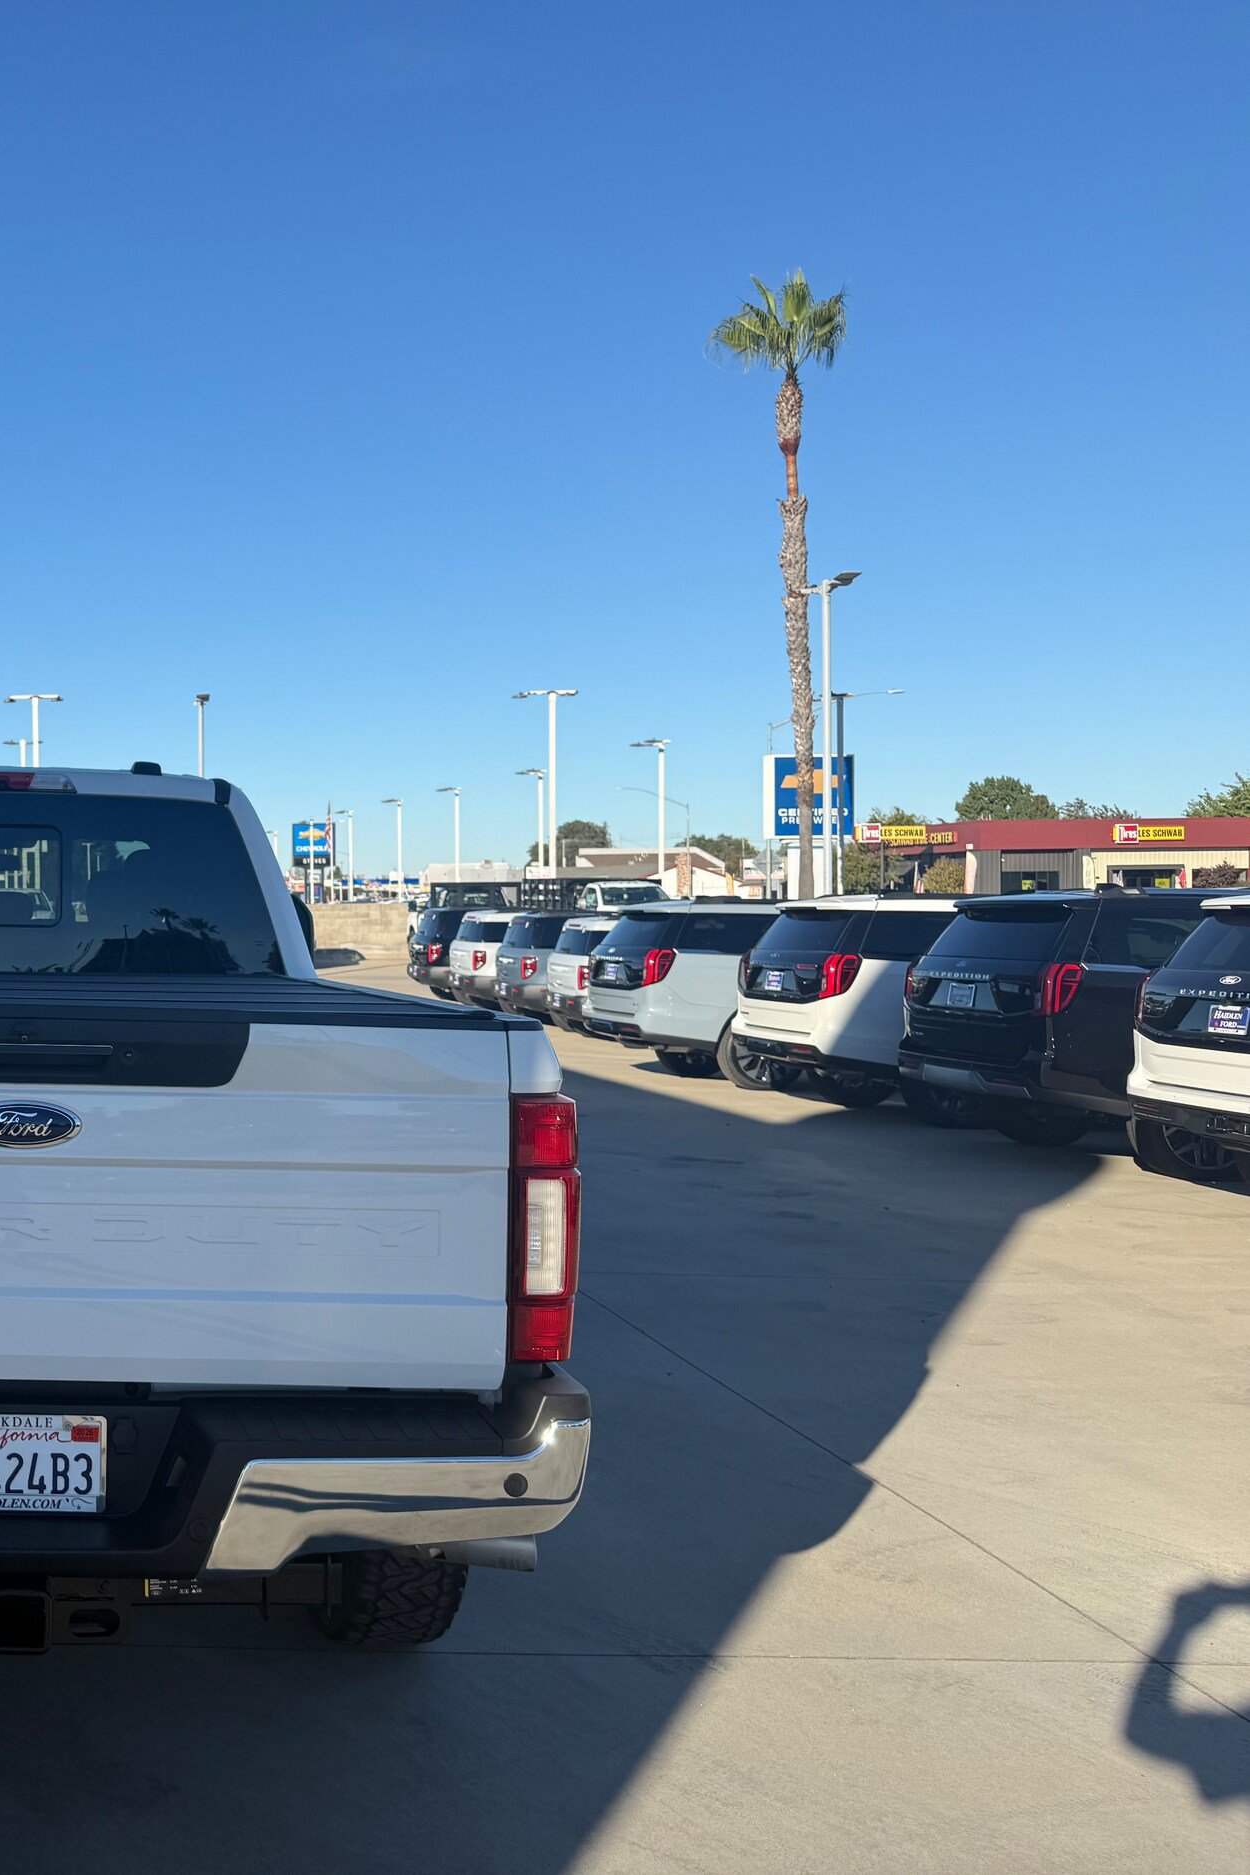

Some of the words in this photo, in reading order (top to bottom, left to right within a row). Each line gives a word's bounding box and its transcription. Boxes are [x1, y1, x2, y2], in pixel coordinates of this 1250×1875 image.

[880, 829, 892, 837] LES
[894, 829, 924, 837] SCHWAB
[1138, 829, 1151, 838] LES
[1152, 829, 1183, 838] SCHWAB
[930, 831, 953, 845] CENTER
[930, 971, 990, 980] EXPEDITION
[1213, 1010, 1243, 1020] HAIDLEN
[1219, 1020, 1238, 1028] FORD
[92, 1214, 426, 1247] DUTY
[76, 1428, 94, 1436] 2026
